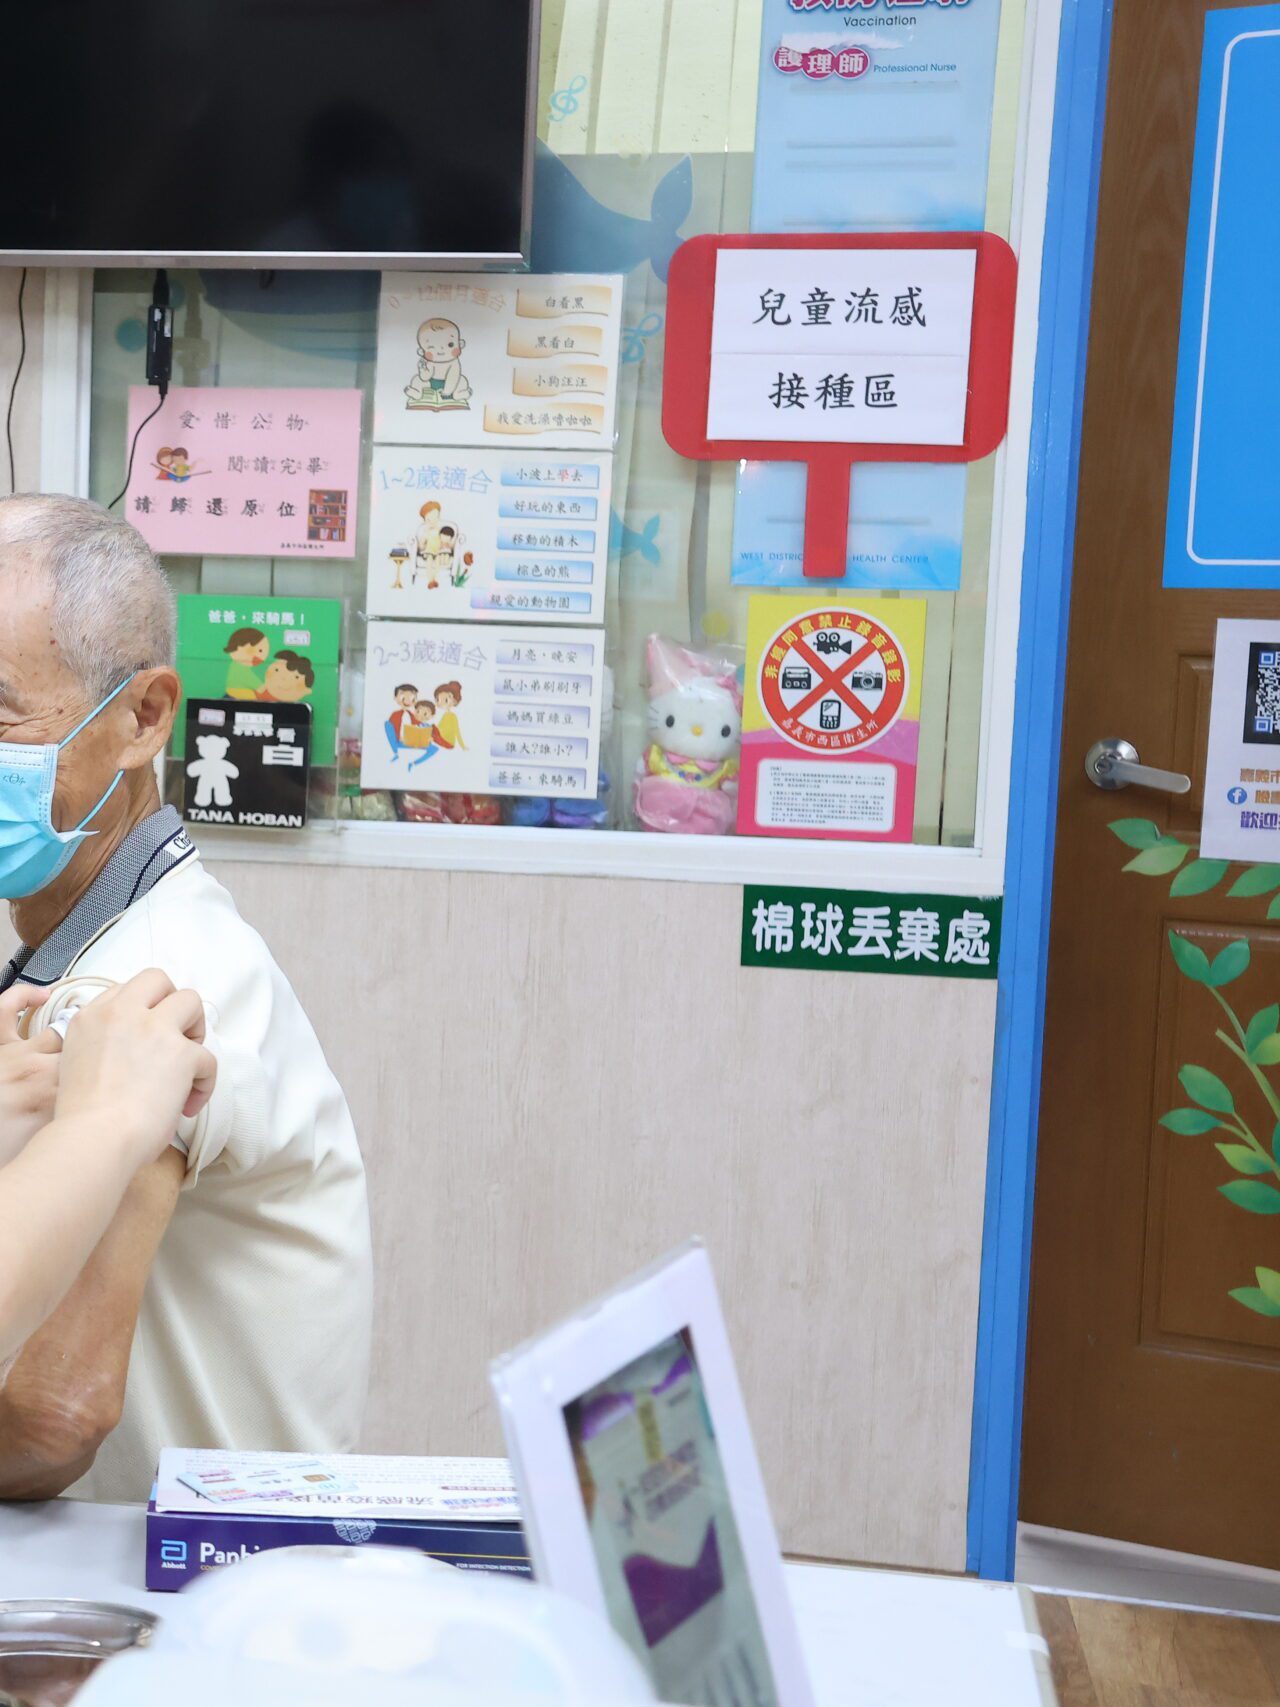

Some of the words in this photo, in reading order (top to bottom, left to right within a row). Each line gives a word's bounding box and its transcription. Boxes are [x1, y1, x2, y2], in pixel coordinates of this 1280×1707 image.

[843, 16, 916, 27] Vaccination
[778, 48, 865, 74] 護理師
[873, 64, 928, 73] Professional
[930, 63, 957, 72] Nurse
[545, 296, 584, 309] 白看黑
[752, 286, 927, 328] 兒童流感
[535, 336, 575, 349] 黑看白
[535, 375, 587, 388] 小狗汪汪
[768, 372, 899, 411] 接種區
[179, 410, 304, 431] 愛惜公物
[227, 456, 323, 476] 閱讀完畢
[134, 496, 296, 518] 請歸還原位
[514, 500, 581, 514] 好玩的東西
[740, 552, 764, 561] WEST
[769, 553, 804, 561] DISTRIC
[852, 554, 887, 563] HEALTH
[517, 564, 570, 578] 棕色的熊
[506, 710, 573, 725] 媽媽買綠豆
[187, 808, 234, 824] TANA
[238, 811, 303, 827] HOBAN
[1240, 811, 1280, 830] 歡迎
[751, 899, 991, 965] 棉球丟棄處
